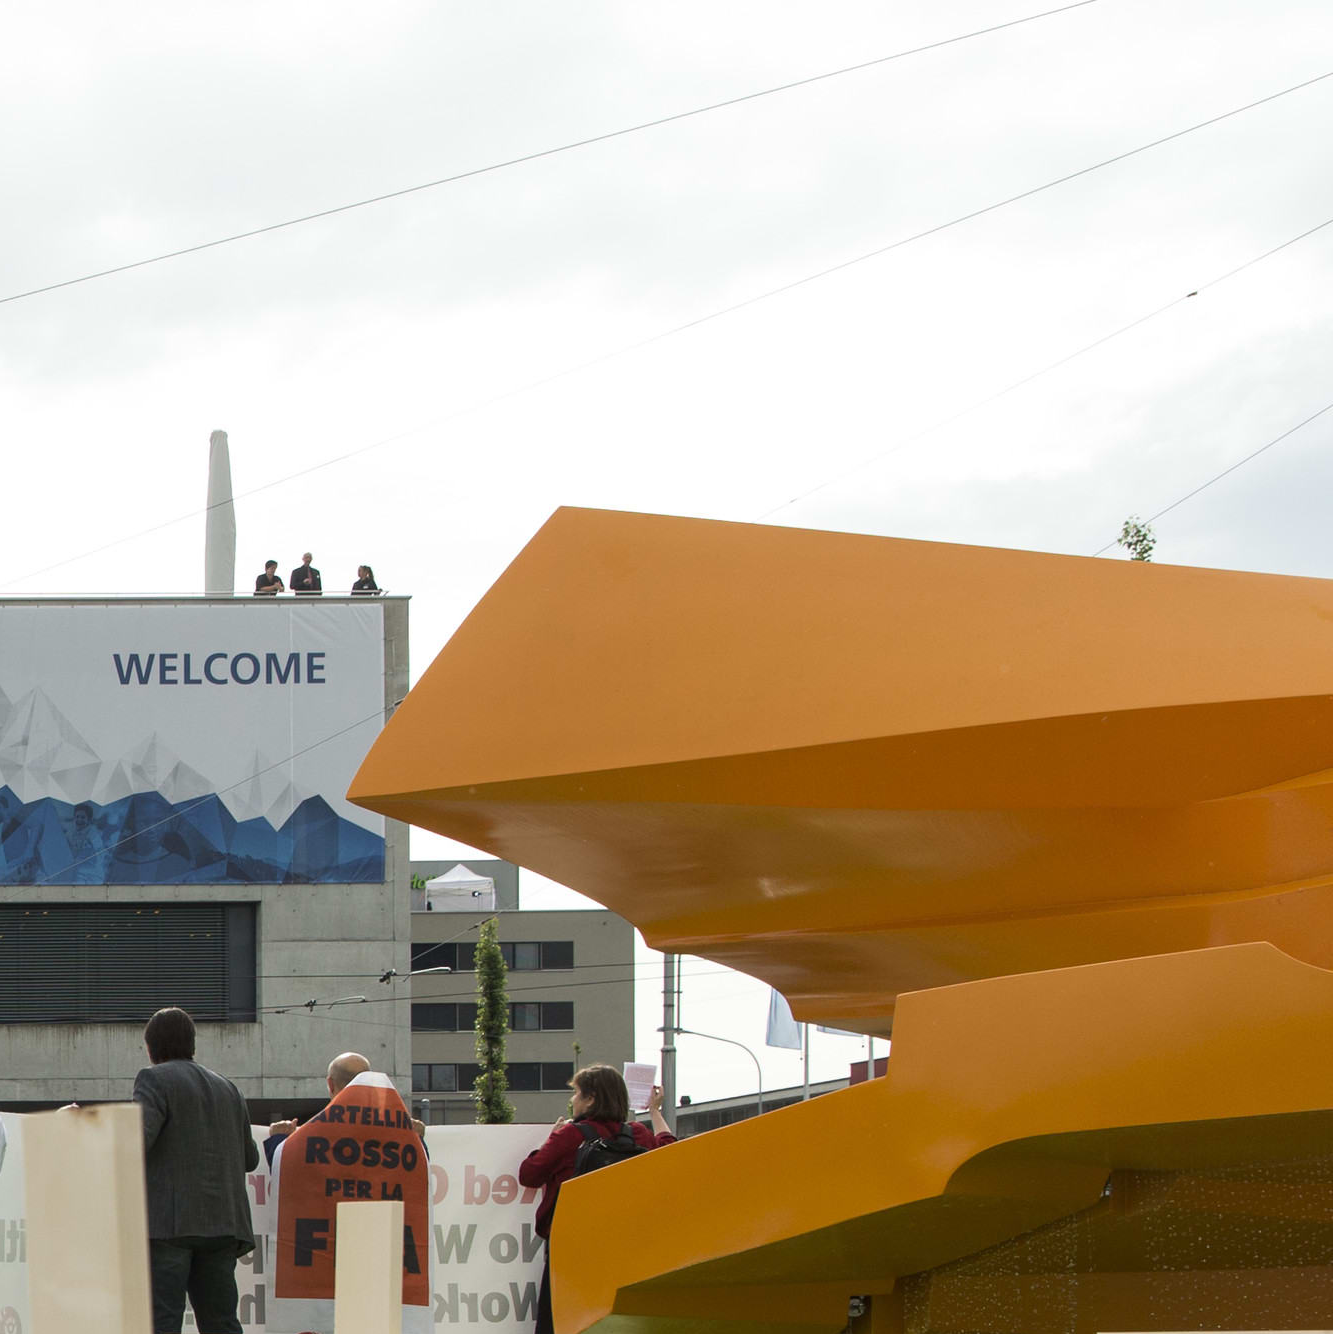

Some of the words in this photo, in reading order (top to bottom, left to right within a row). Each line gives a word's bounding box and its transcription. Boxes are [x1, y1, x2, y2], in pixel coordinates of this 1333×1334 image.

[113, 652, 326, 685] WELCOME
[310, 1104, 413, 1131] ARTELLIN
[305, 1136, 418, 1172] ROSSO
[325, 1178, 373, 1199] PER
[381, 1182, 404, 1201] LA
